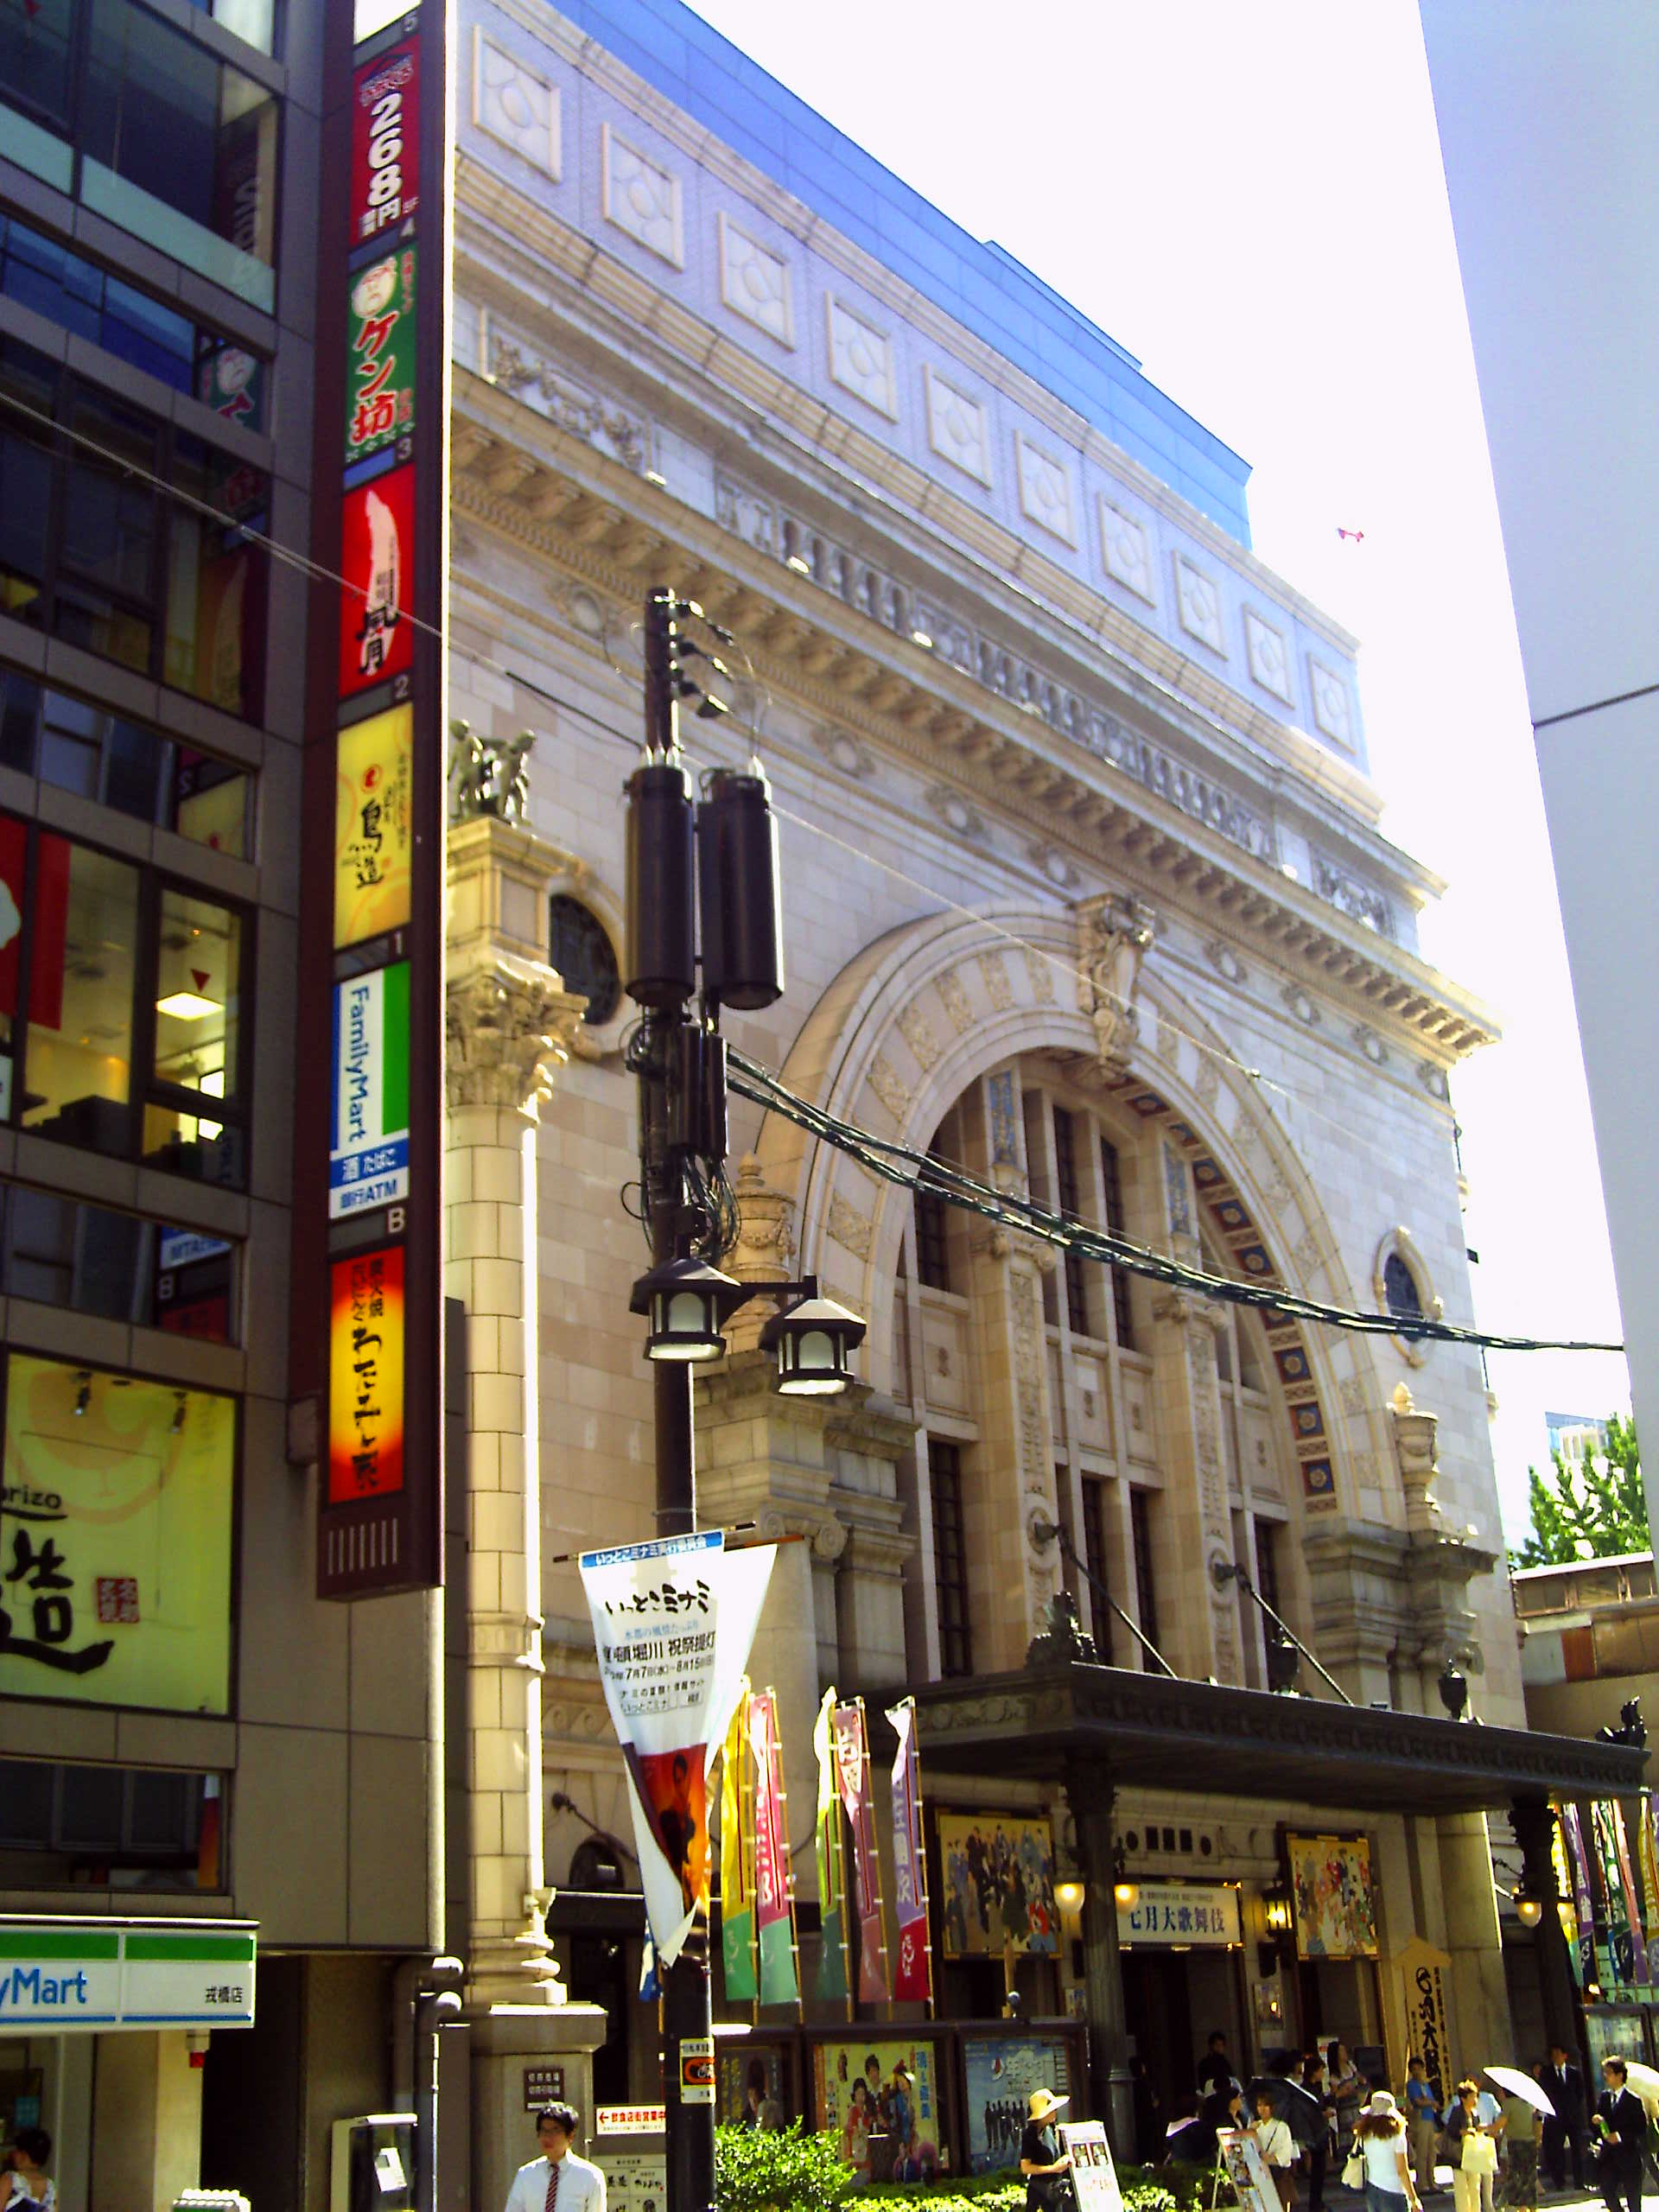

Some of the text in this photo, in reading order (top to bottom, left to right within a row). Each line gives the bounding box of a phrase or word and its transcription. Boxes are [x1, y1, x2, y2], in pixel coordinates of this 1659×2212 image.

[397, 437, 412, 460] 3
[394, 675, 410, 698] 2
[345, 985, 369, 1143] FamilyMart
[388, 1208, 405, 1233] B
[1130, 1905, 1225, 1934] 七月大歌舞伎
[205, 1986, 244, 2005] 戎橋店
